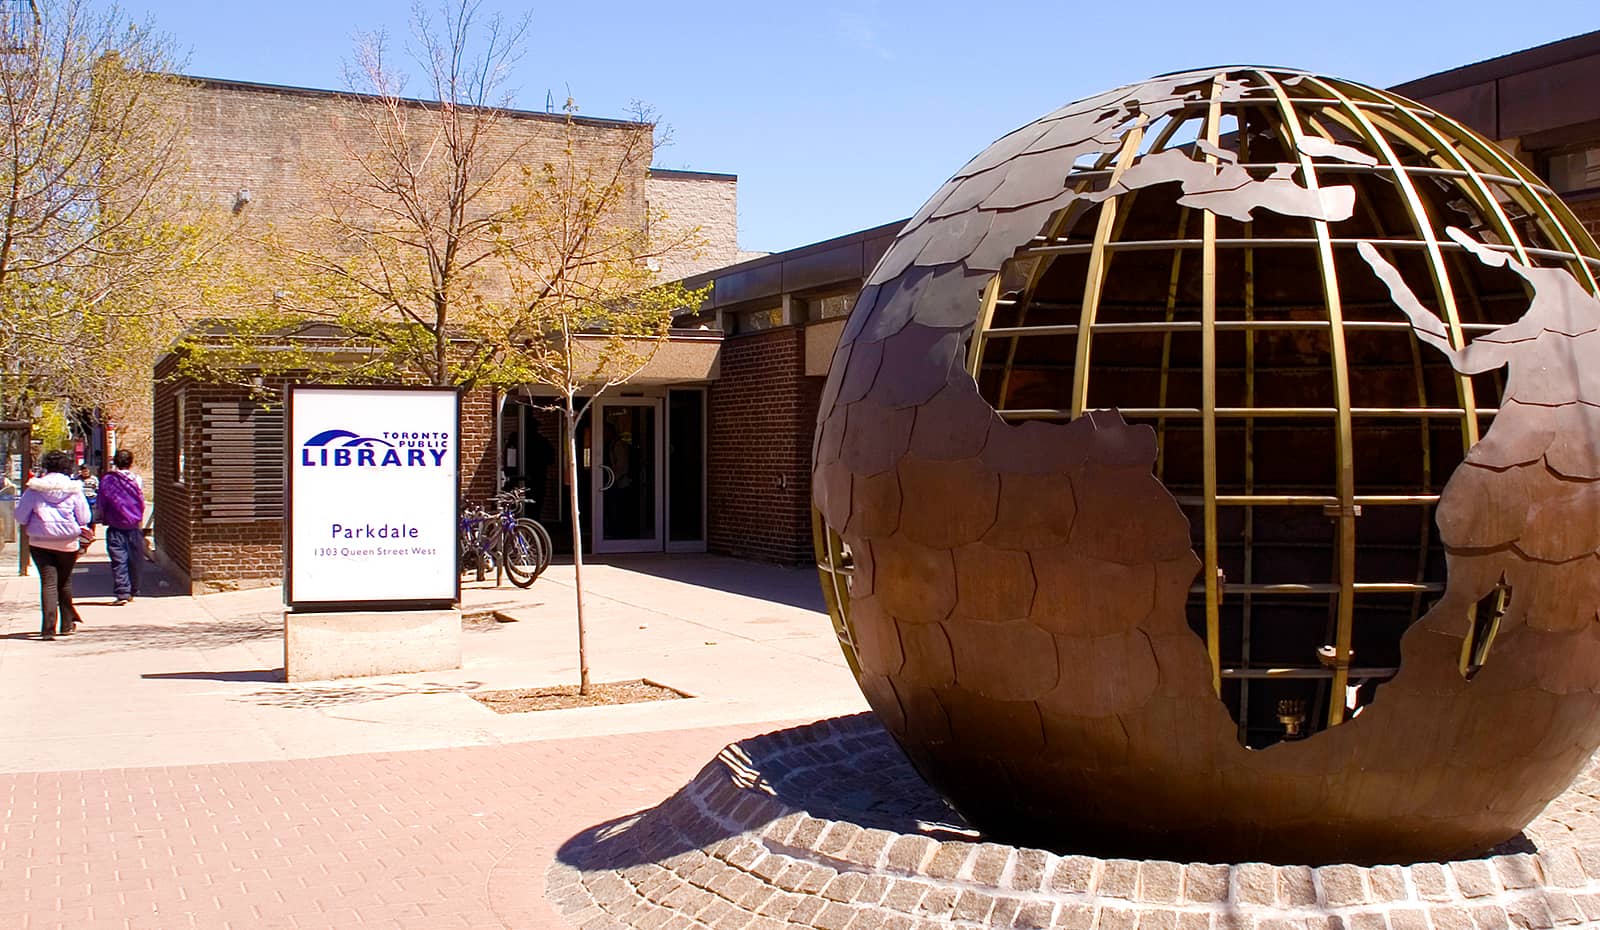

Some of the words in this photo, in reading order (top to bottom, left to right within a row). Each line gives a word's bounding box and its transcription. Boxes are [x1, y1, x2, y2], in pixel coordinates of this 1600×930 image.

[383, 431, 449, 440] TORONTO
[399, 440, 448, 448] PUBLIC
[302, 448, 448, 467] LIBRARY
[332, 524, 419, 539] Parkdale
[314, 548, 338, 557] 1303
[341, 548, 375, 557] Queen
[377, 547, 409, 556] Street
[411, 547, 436, 556] West
